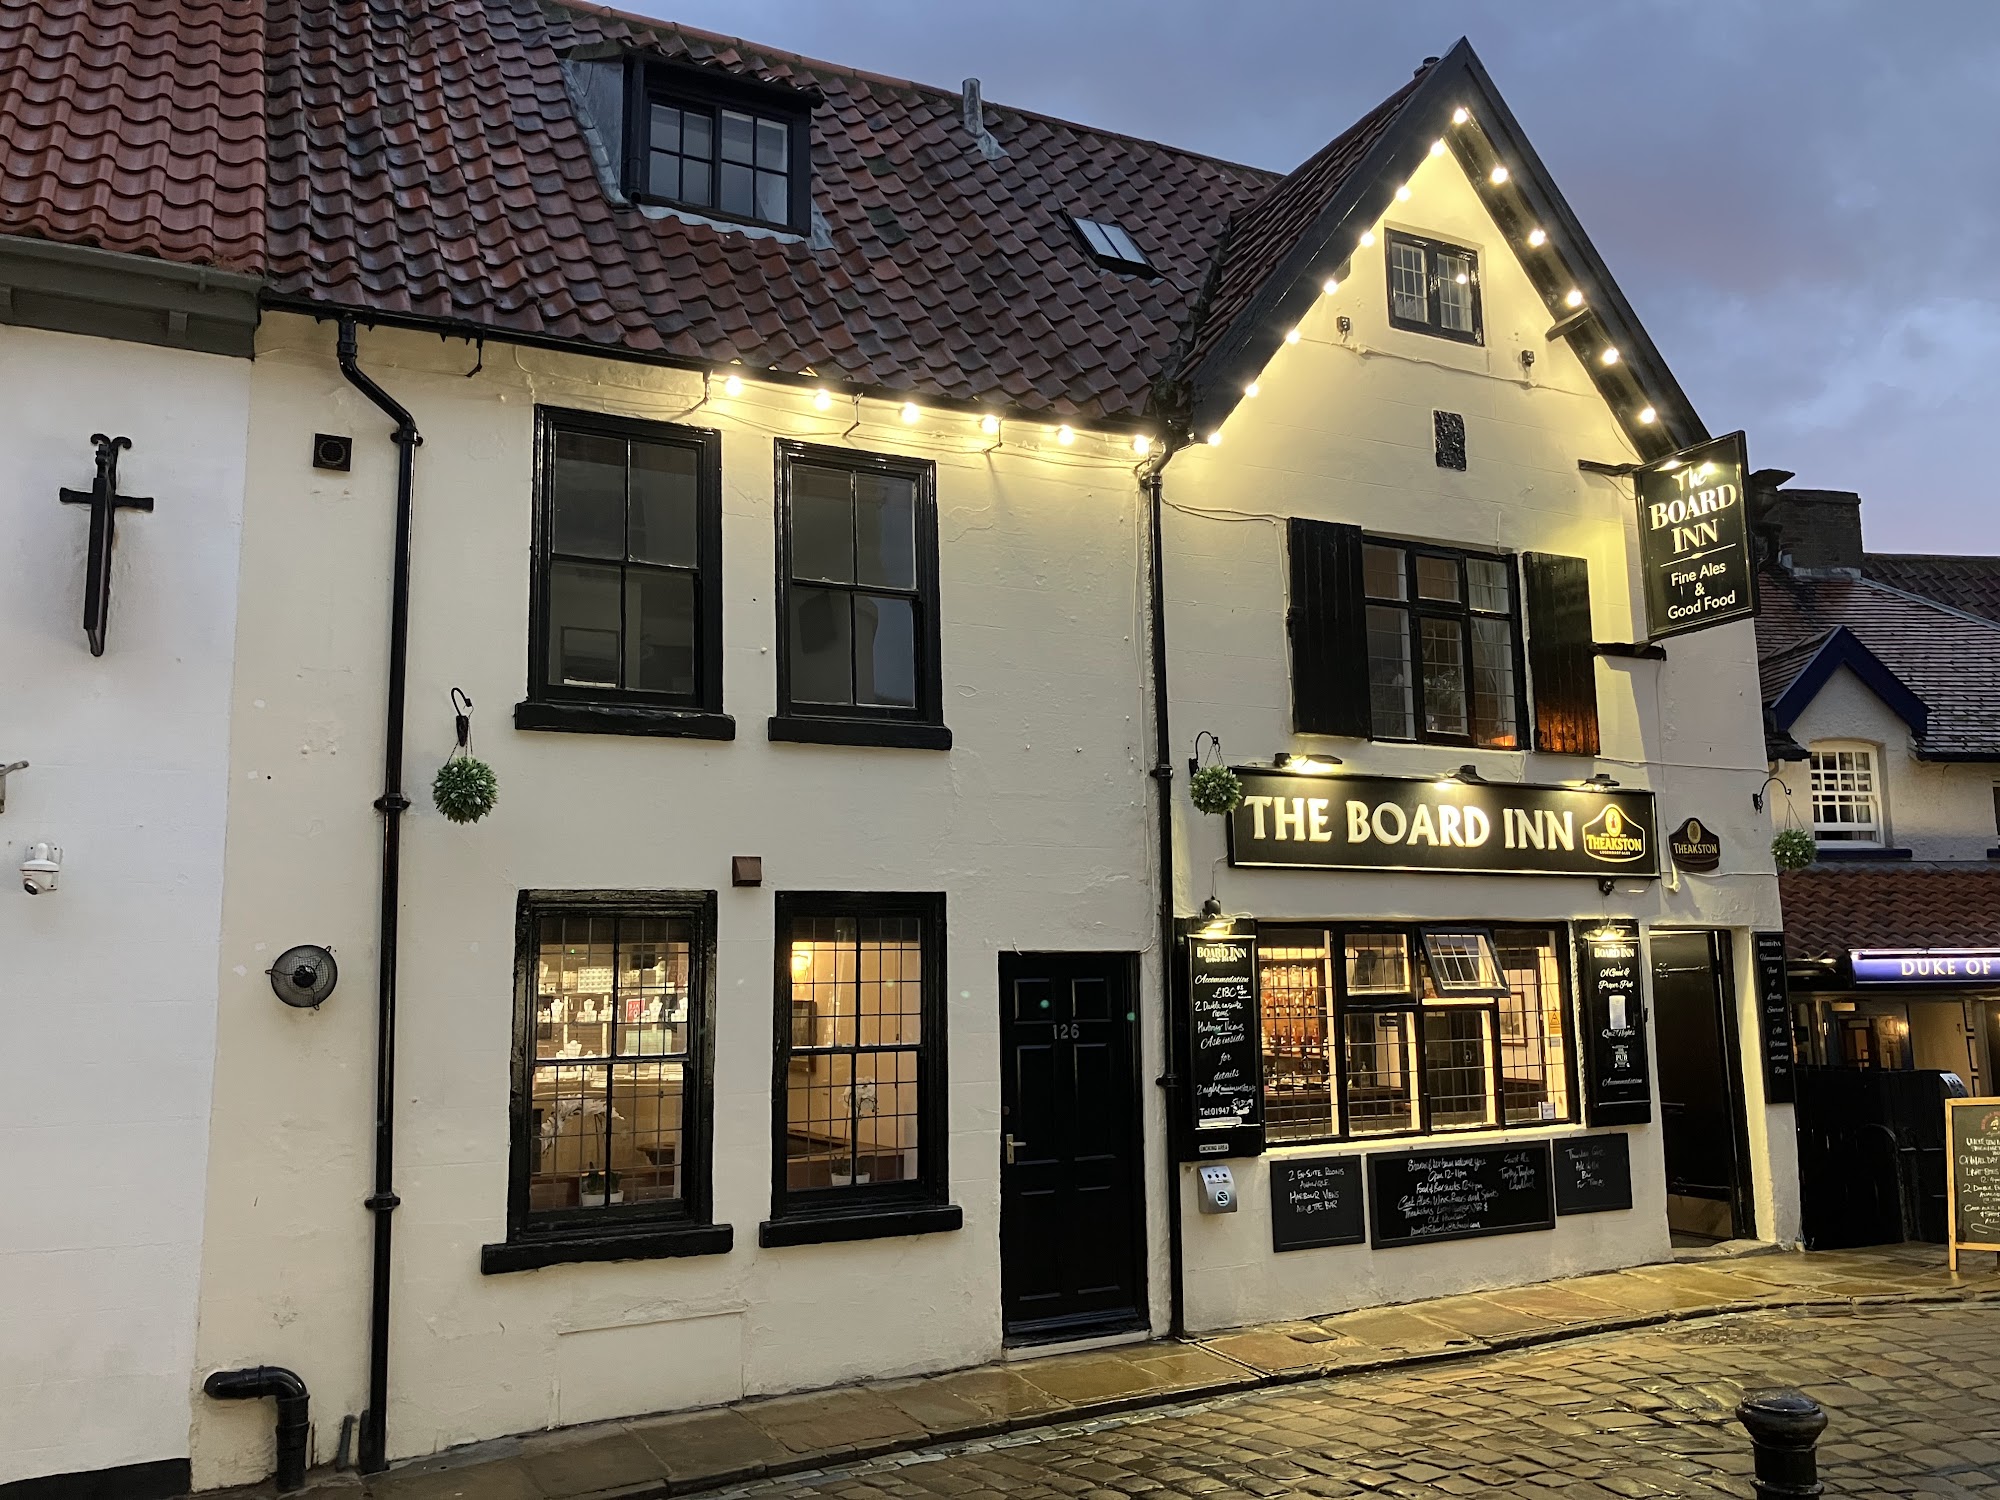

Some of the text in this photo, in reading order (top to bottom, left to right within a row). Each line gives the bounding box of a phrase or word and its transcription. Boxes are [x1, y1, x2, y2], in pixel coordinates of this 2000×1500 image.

[1671, 466, 1707, 491] The
[1648, 483, 1737, 531] BOARD
[1670, 518, 1718, 555] INN
[1671, 561, 1726, 587] Fine Ales
[1694, 583, 1705, 597] &
[1667, 590, 1736, 620] Good Food
[1244, 795, 1574, 851] THE BOARD INN
[1586, 834, 1642, 851] THEAKSTON
[1673, 842, 1718, 854] THEAKSTON
[1196, 946, 1247, 958] BOARD INN
[1901, 959, 1992, 976] DUKE OF
[1195, 1001, 1202, 1012] 2
[1053, 1023, 1080, 1040] 126
[1200, 1033, 1245, 1049] Ask inside
[1218, 1052, 1232, 1066] for
[1214, 1068, 1239, 1081] details
[1197, 1084, 1203, 1096] 2
[1288, 1170, 1295, 1181] 2
[1963, 1183, 1972, 1193] 2
